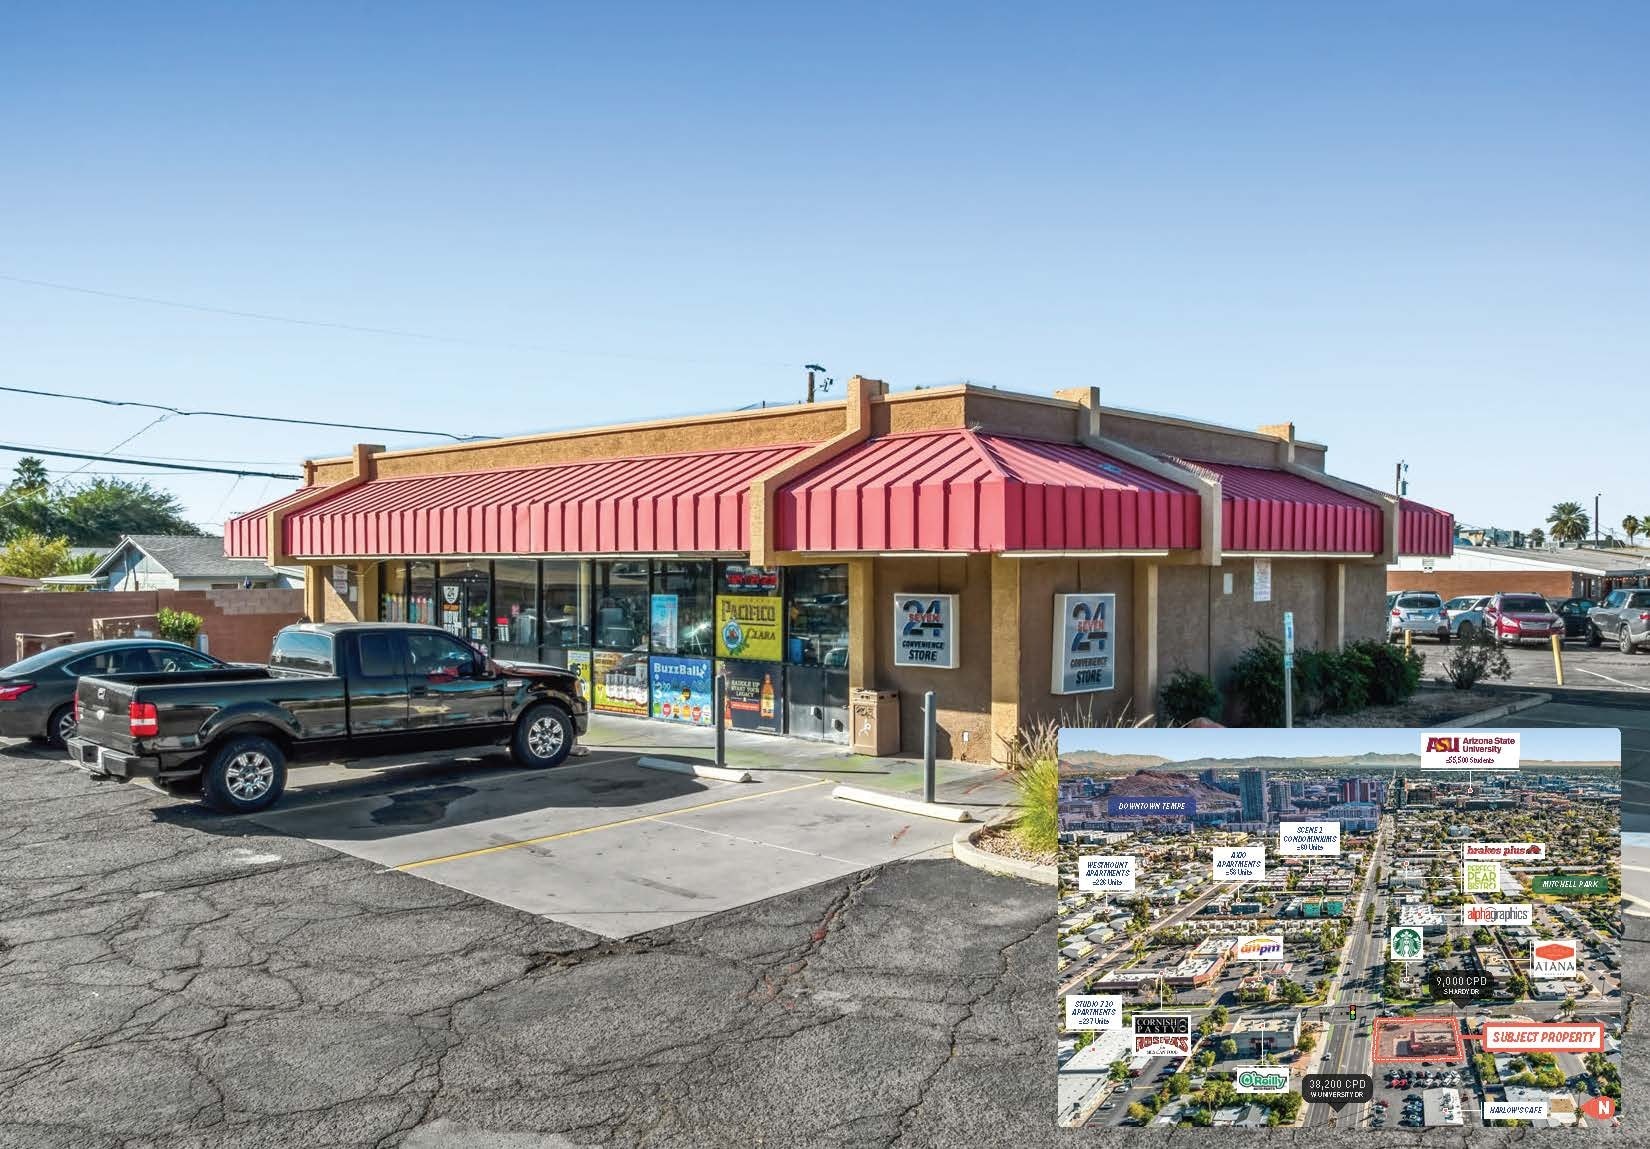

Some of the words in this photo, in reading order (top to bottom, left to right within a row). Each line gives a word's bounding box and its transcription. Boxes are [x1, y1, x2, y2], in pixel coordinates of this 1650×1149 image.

[903, 600, 944, 637] 24
[908, 613, 941, 622] SEVEN
[1072, 602, 1108, 651] 24
[1078, 620, 1104, 632] SEVEN
[902, 640, 944, 649] CONVENIENCE
[909, 649, 937, 661] STORE
[1071, 656, 1108, 668] CONVENIENCE
[1076, 669, 1102, 684] STORE
